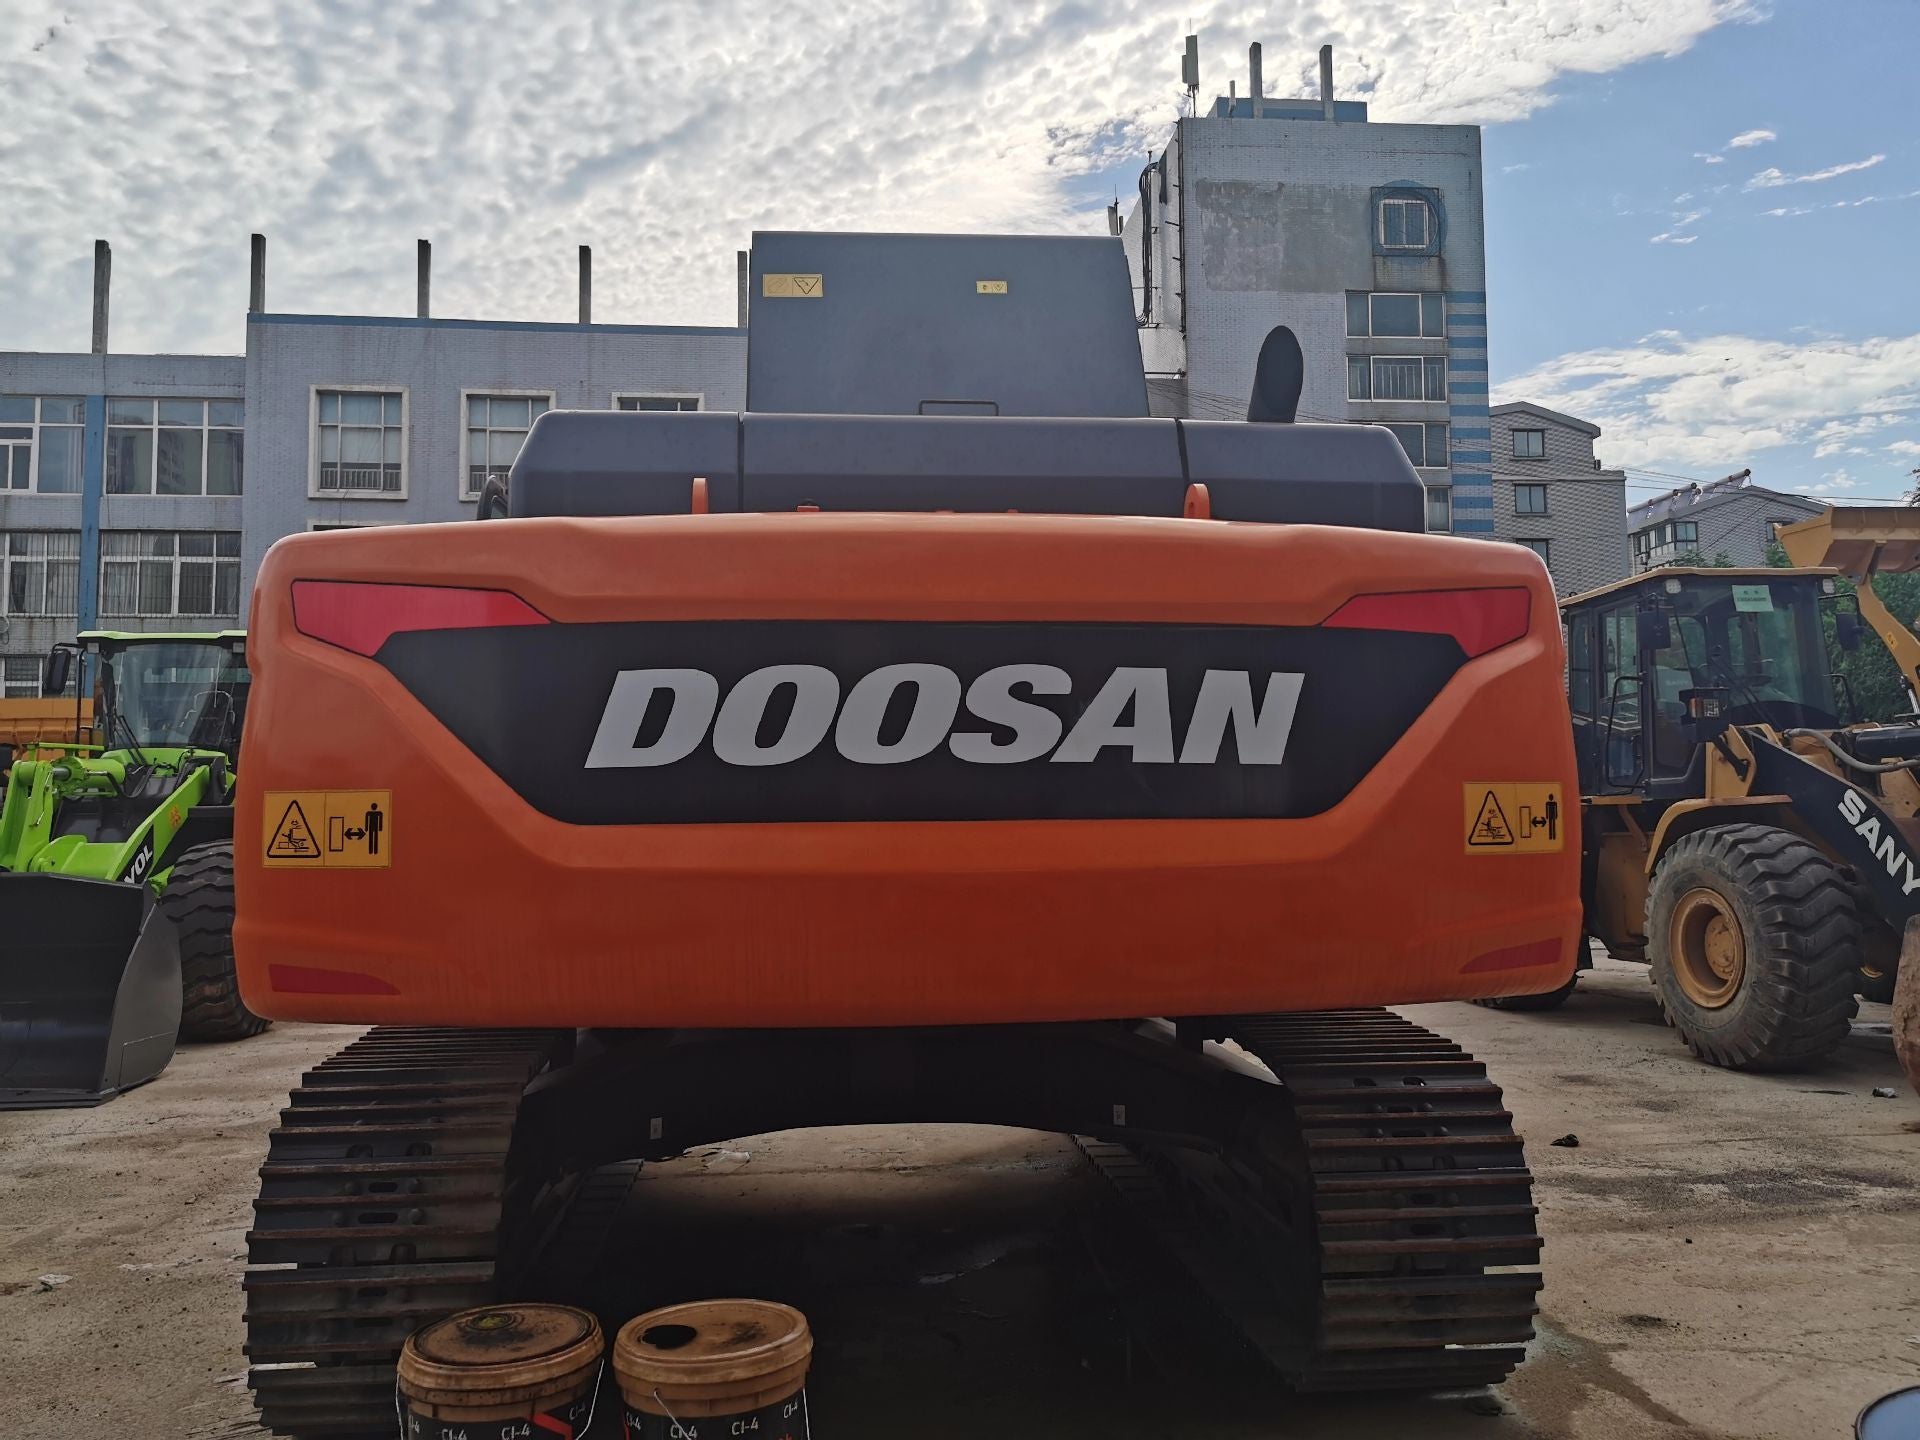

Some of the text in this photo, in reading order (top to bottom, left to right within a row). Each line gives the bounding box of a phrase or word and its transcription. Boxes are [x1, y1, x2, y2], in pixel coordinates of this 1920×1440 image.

[584, 663, 1305, 769] DOOSAN
[1837, 788, 1920, 896] SANY
[670, 1424, 698, 1439] CI4
[731, 1416, 759, 1436] CI-4
